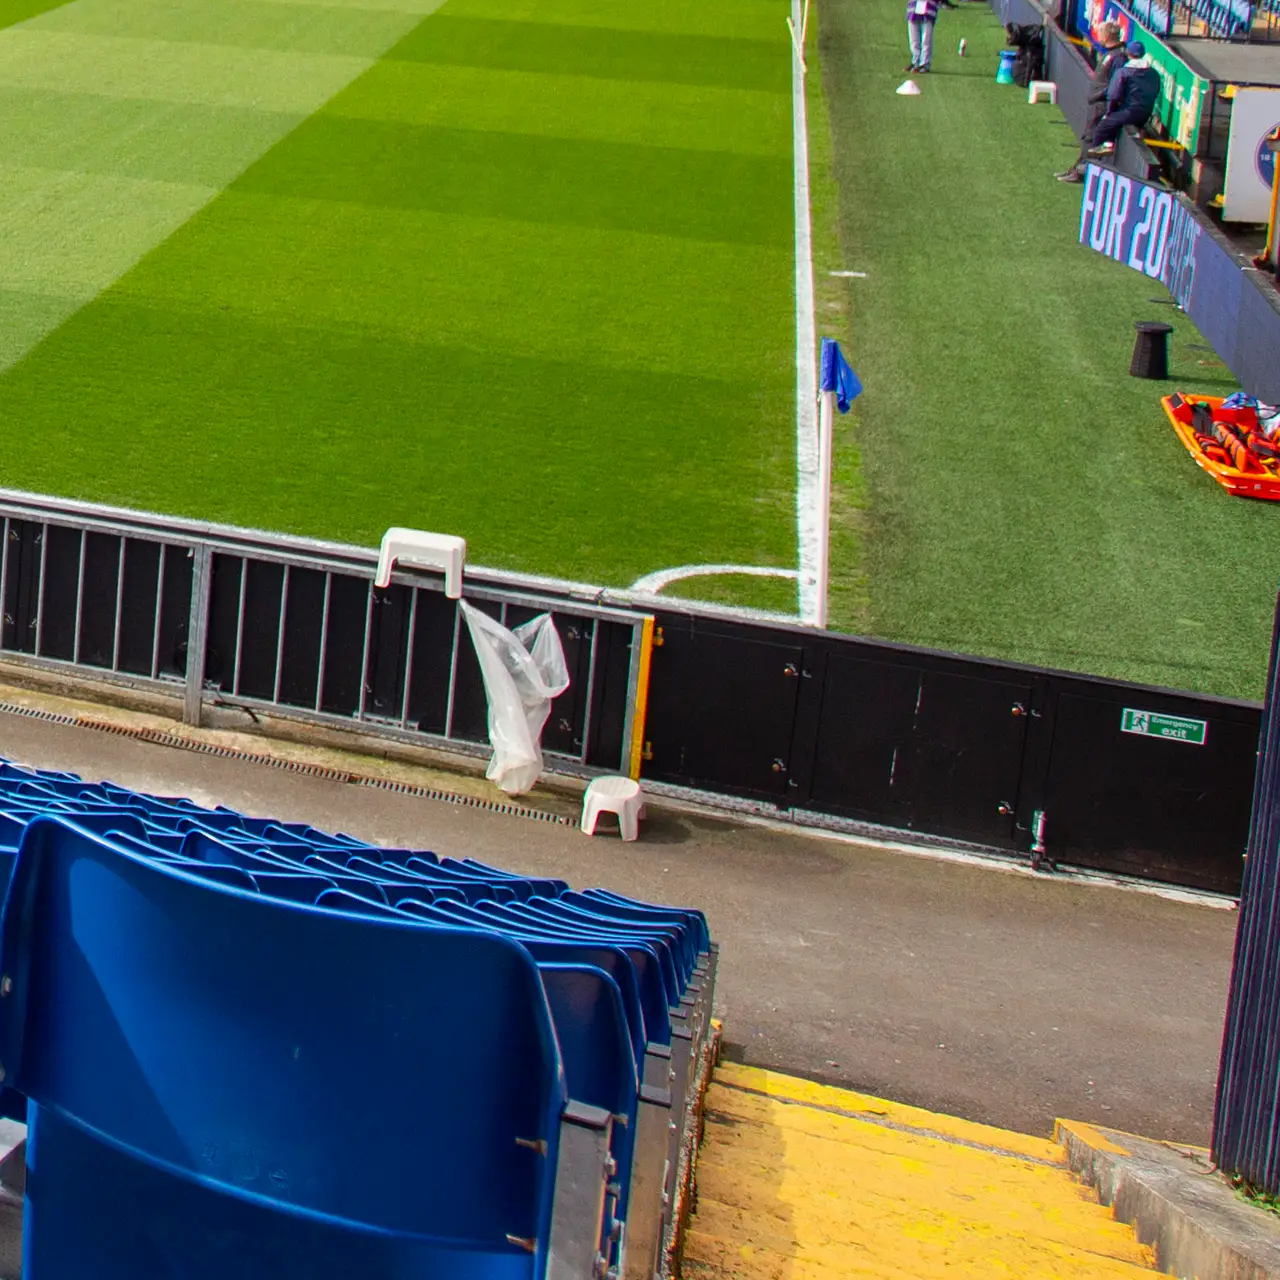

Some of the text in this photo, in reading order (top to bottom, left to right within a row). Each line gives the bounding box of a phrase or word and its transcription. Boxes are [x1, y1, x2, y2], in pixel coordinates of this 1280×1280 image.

[1079, 163, 1132, 262] FOR
[1151, 715, 1199, 731] Emergency
[1161, 727, 1188, 739] exit
